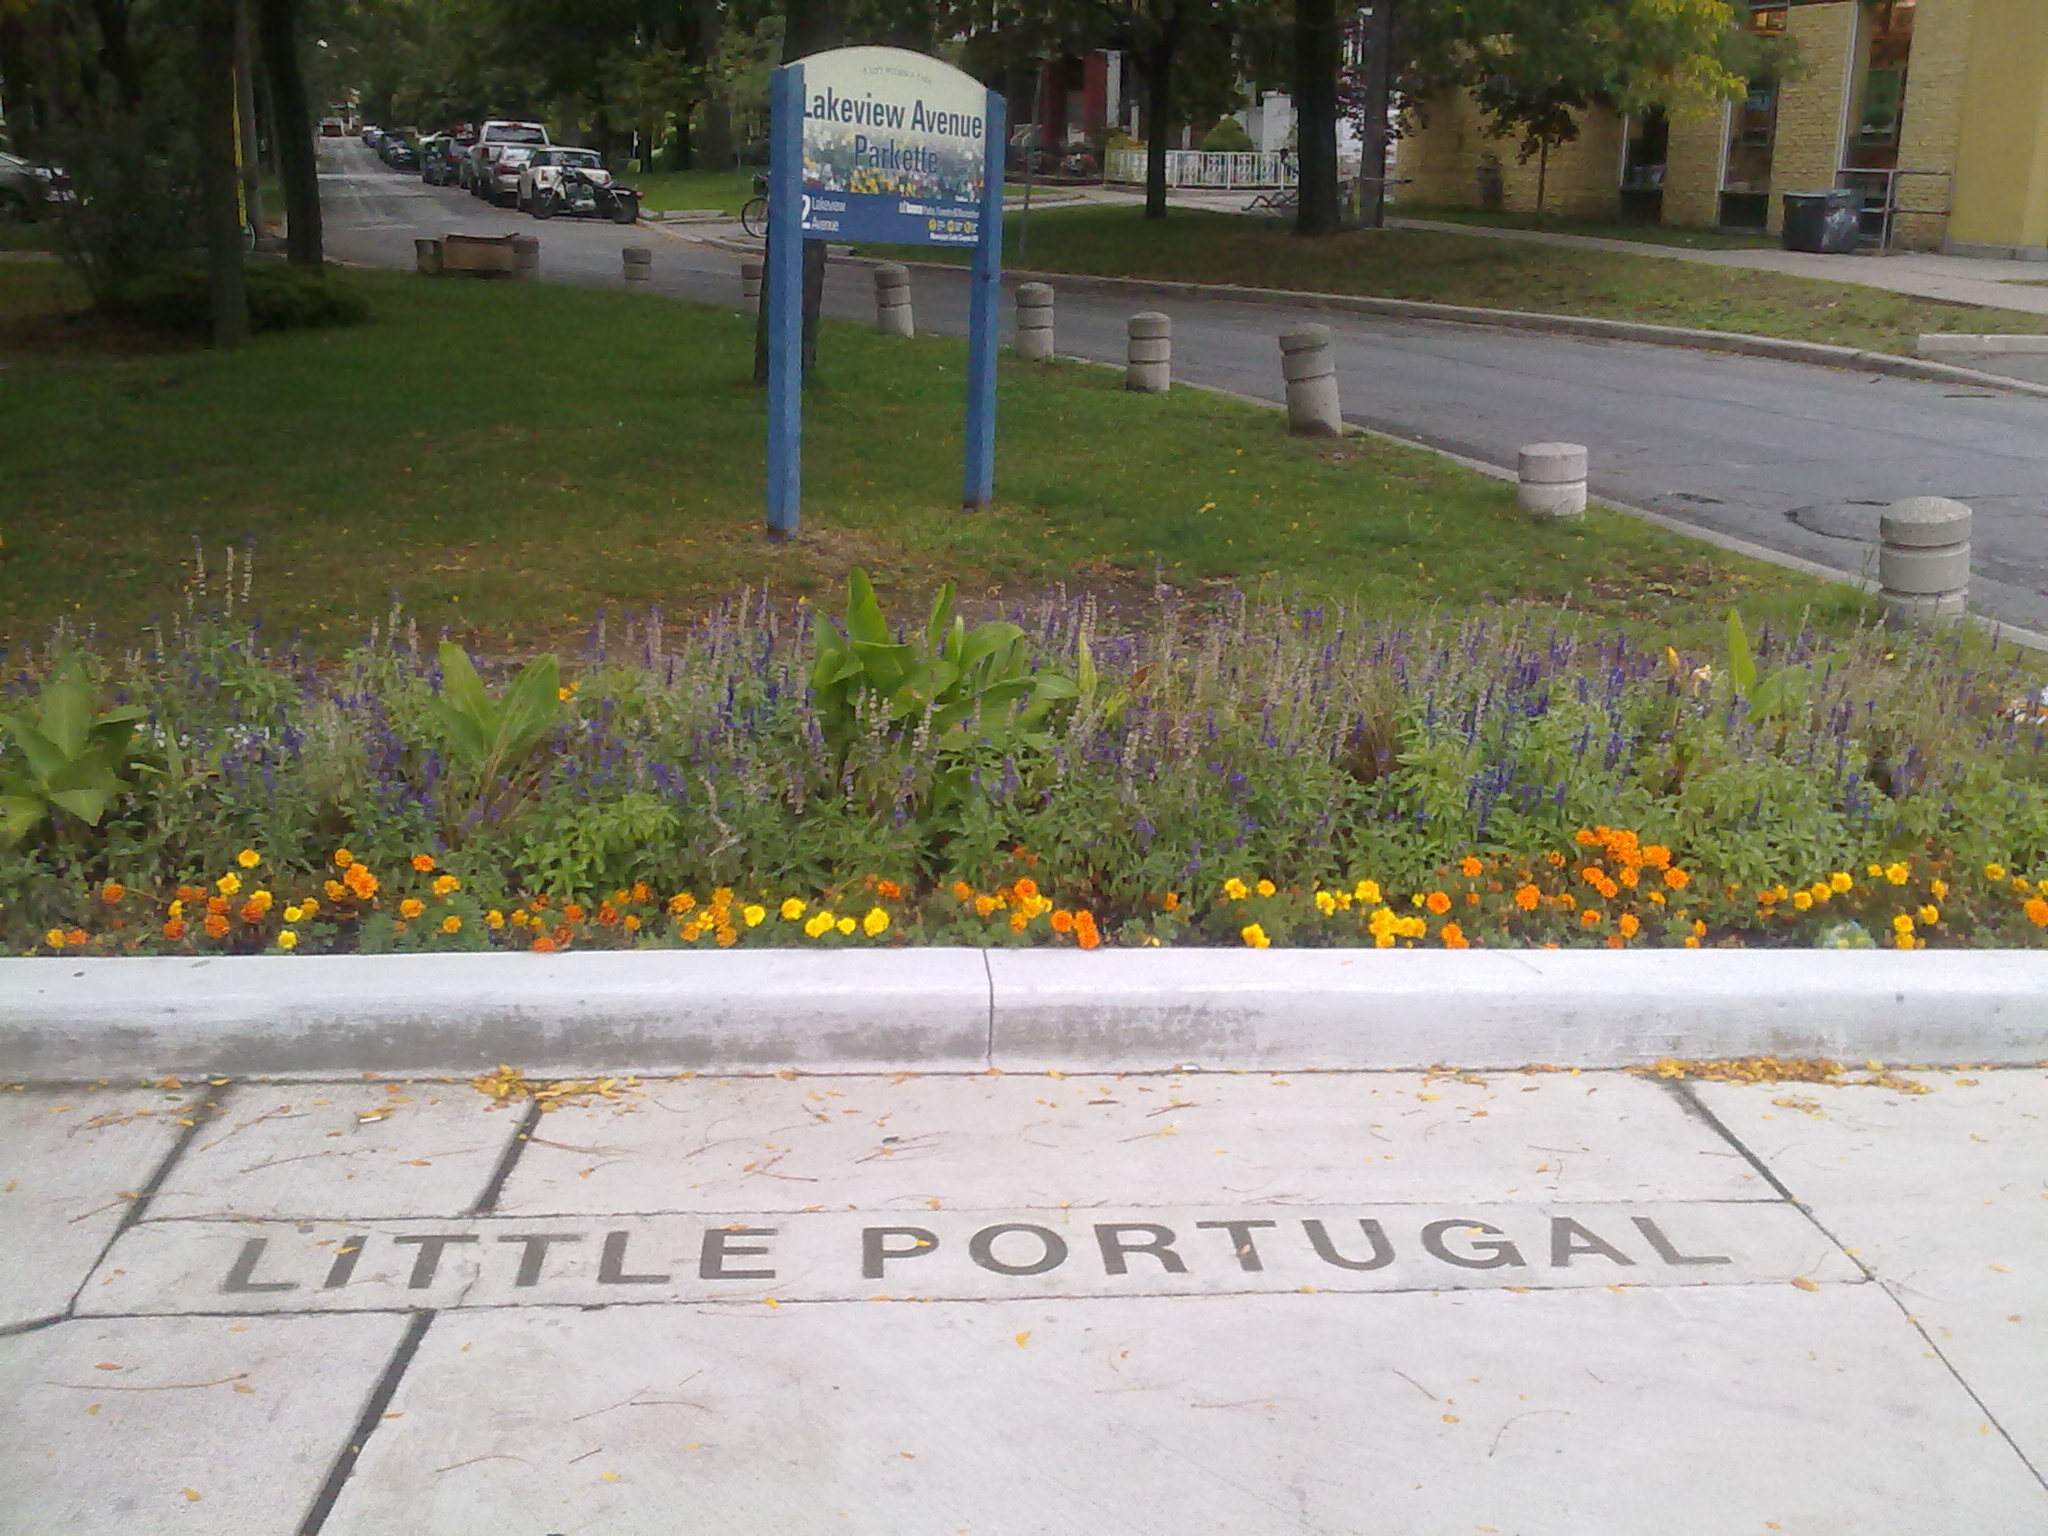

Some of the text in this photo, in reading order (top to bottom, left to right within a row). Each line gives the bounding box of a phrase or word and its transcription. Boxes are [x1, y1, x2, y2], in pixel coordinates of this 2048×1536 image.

[803, 83, 982, 139] Lakeview Avenue
[855, 134, 938, 174] Parkette
[220, 1215, 1732, 1293] LITTLE PORTUGAL
